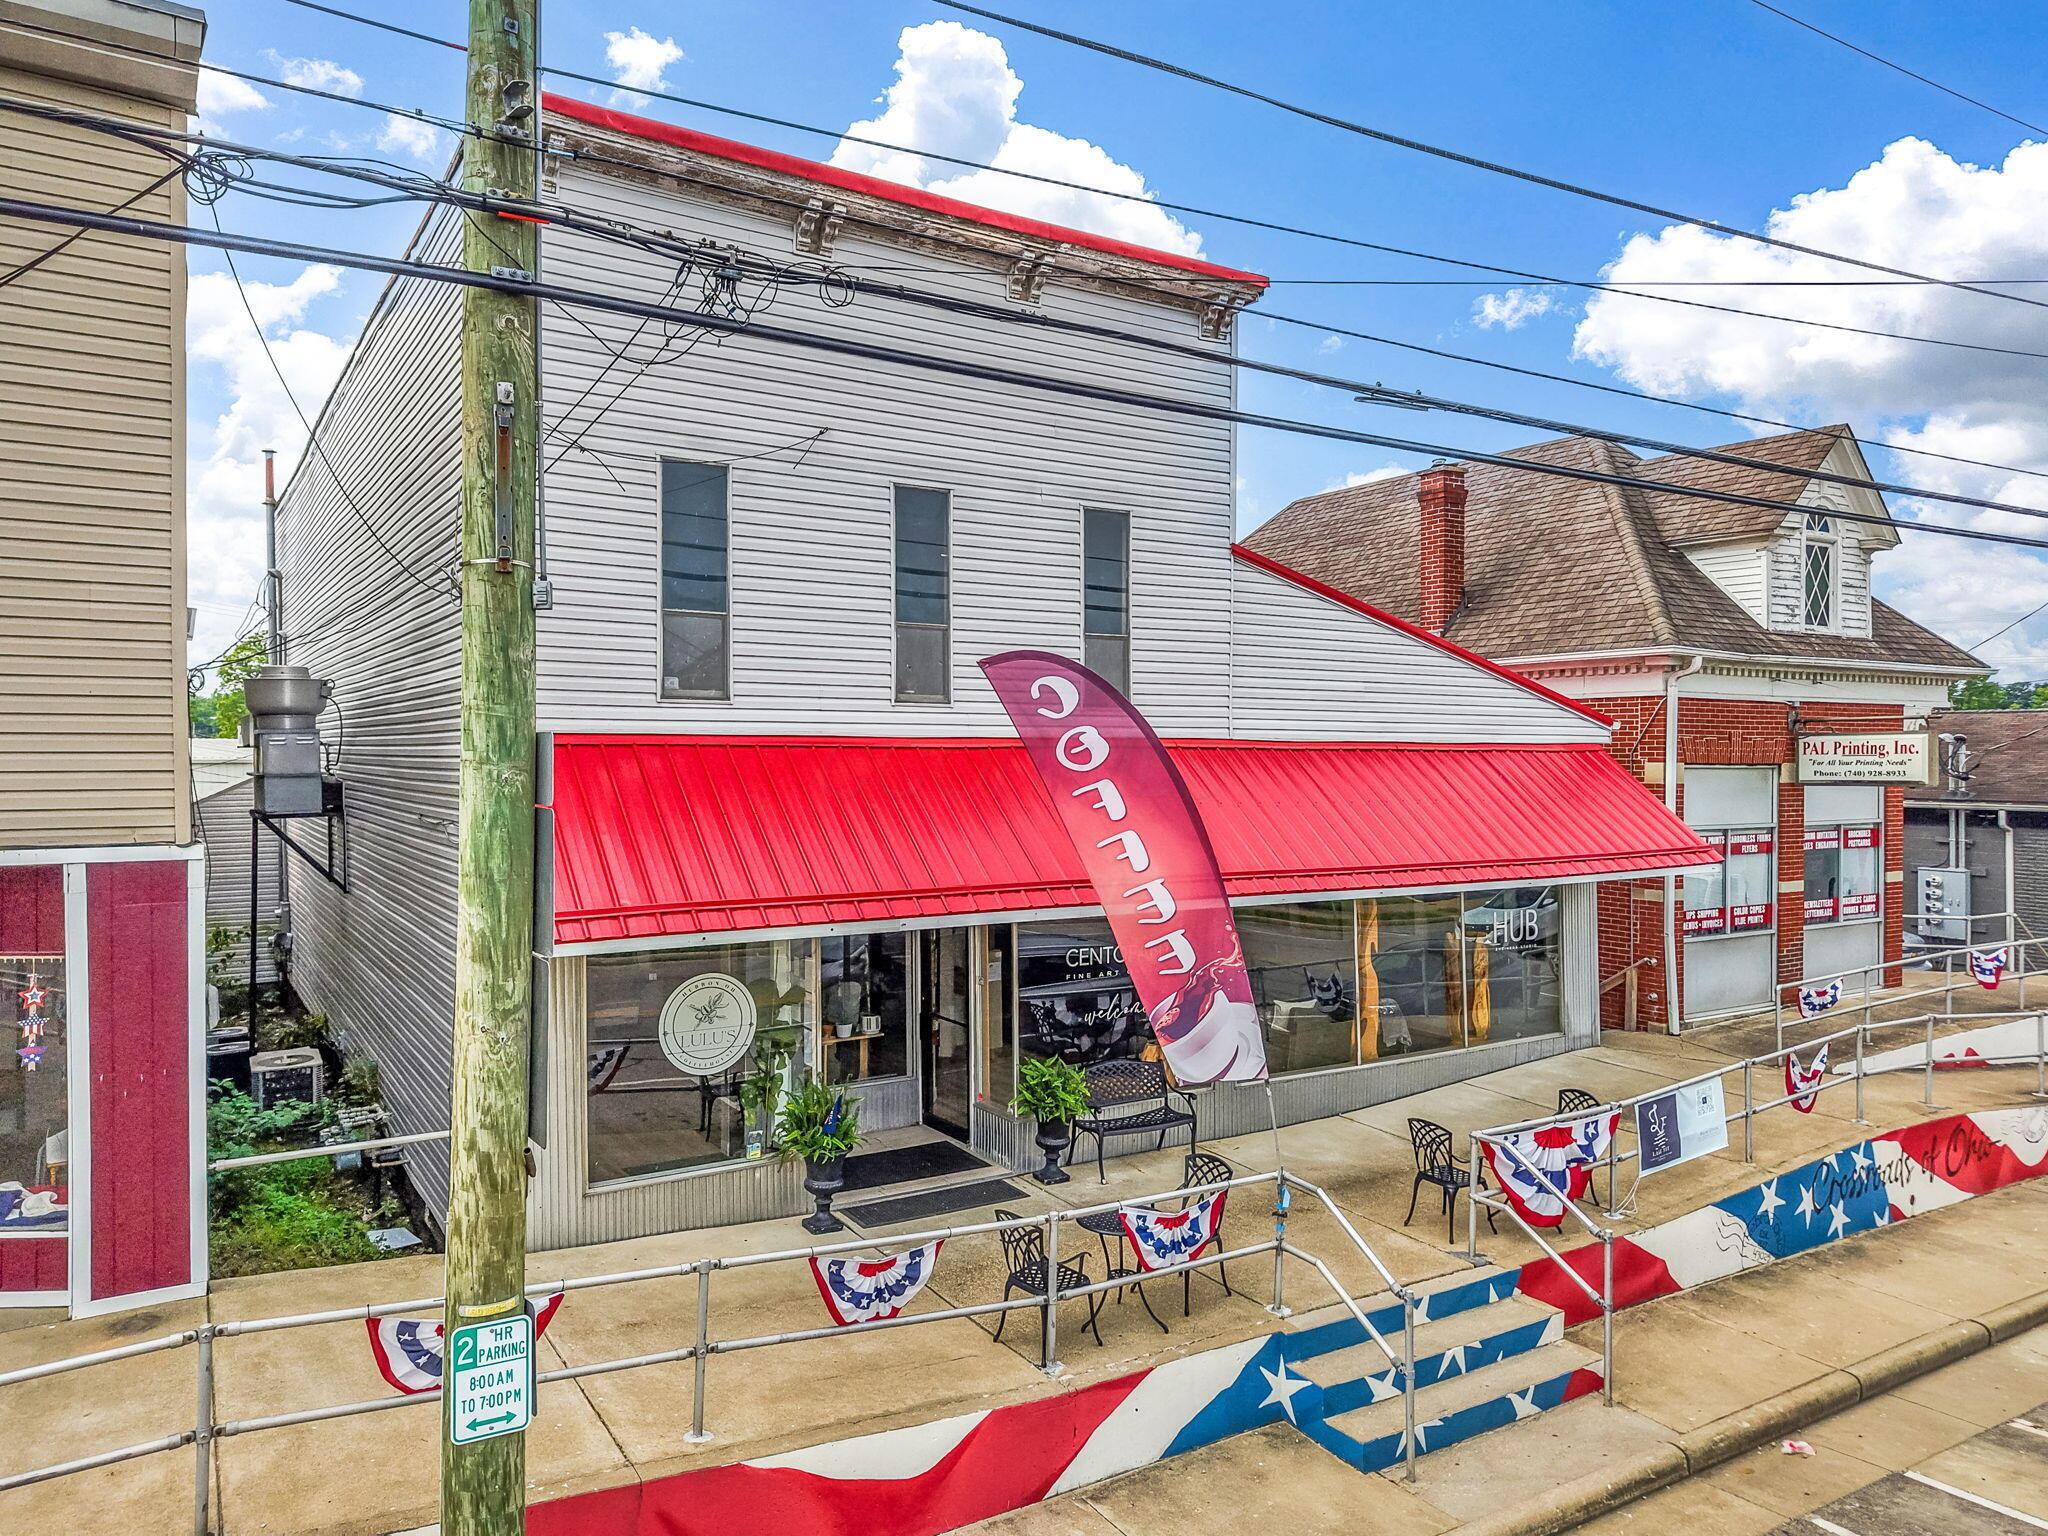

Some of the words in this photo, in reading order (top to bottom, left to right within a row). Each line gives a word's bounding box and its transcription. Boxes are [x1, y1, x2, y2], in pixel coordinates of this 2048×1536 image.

[1803, 741, 1829, 755] PAL
[1834, 741, 1890, 758] Printing,
[1894, 740, 1919, 754] Inc.
[1855, 759, 1884, 767] Printing
[1843, 770, 1865, 778] (740)
[1756, 833, 1772, 843] FORMS
[1847, 829, 1871, 838] BROCHURES
[1741, 844, 1758, 853] FLYERS
[1847, 839, 1871, 848] POSTCARDS
[1862, 894, 1877, 903] CARDS
[1733, 906, 1749, 916] COLOR
[1749, 905, 1765, 915] COPIES
[1804, 908, 1833, 919] LETTERHEADS
[1859, 903, 1876, 913] STAMPS
[1685, 910, 1696, 920] UPS
[1696, 908, 1719, 919] SHIPPING
[1493, 909, 1538, 943] HUB
[1701, 918, 1724, 929] INVOICES
[1734, 917, 1747, 926] BLUE
[1747, 915, 1764, 925] PRINTS
[1065, 972, 1092, 980] FINE
[1099, 969, 1120, 978] ART
[680, 1029, 737, 1048] LULU'S
[1811, 1148, 1914, 1213] Crossroads
[1921, 1135, 1942, 1183] of
[457, 1336, 474, 1366] 2
[494, 1325, 514, 1341] HR
[478, 1340, 526, 1363] PARKING
[461, 1399, 476, 1414] TO
